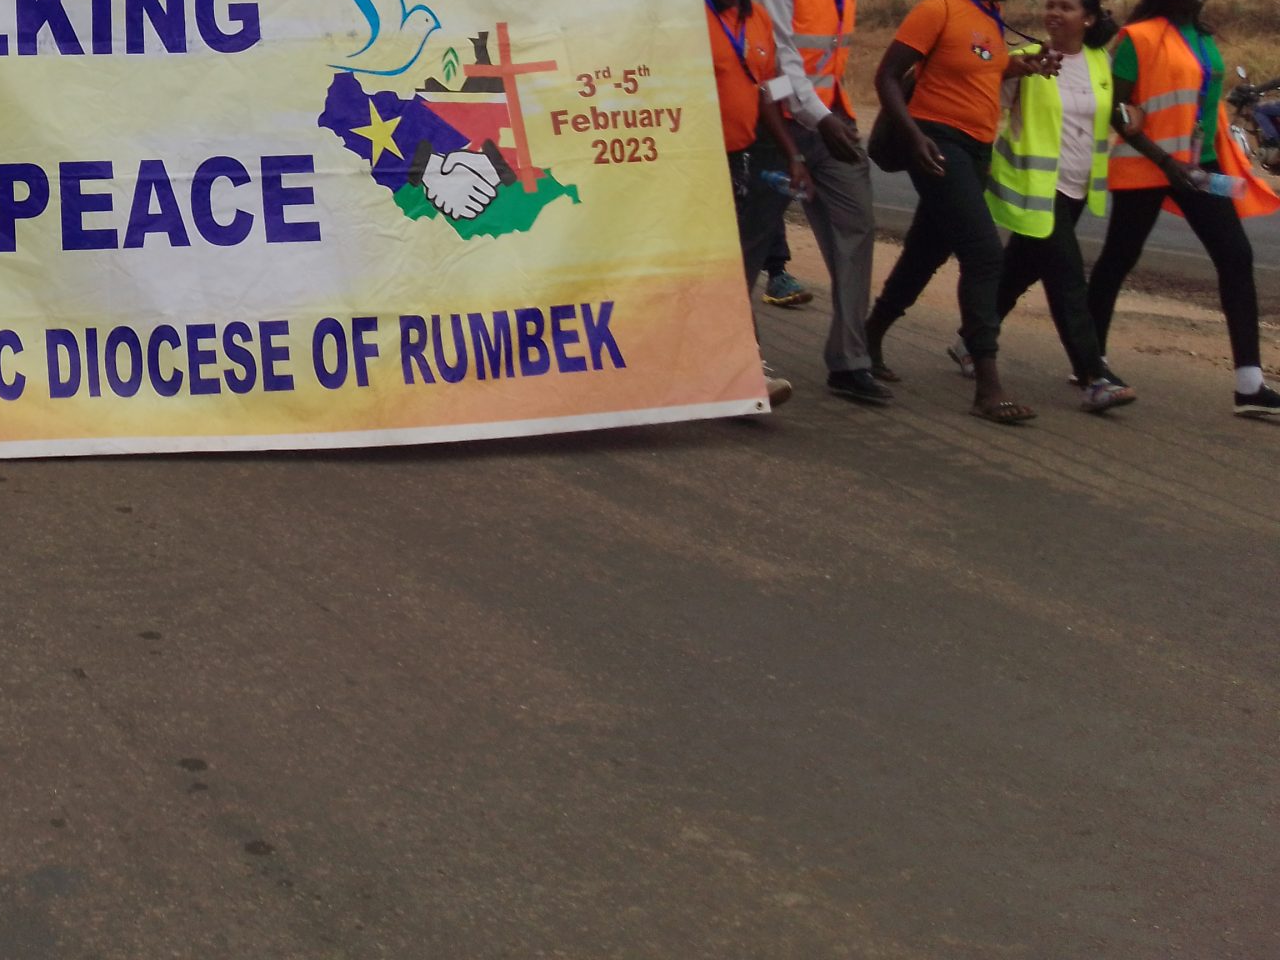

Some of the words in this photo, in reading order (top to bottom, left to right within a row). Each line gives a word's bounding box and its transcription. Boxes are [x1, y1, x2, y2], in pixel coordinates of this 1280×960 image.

[550, 106, 682, 136] February
[591, 136, 658, 165] 2023
[45, 320, 295, 400] DIOCESE
[312, 315, 380, 390] OF
[400, 300, 627, 386] RUMBEK
